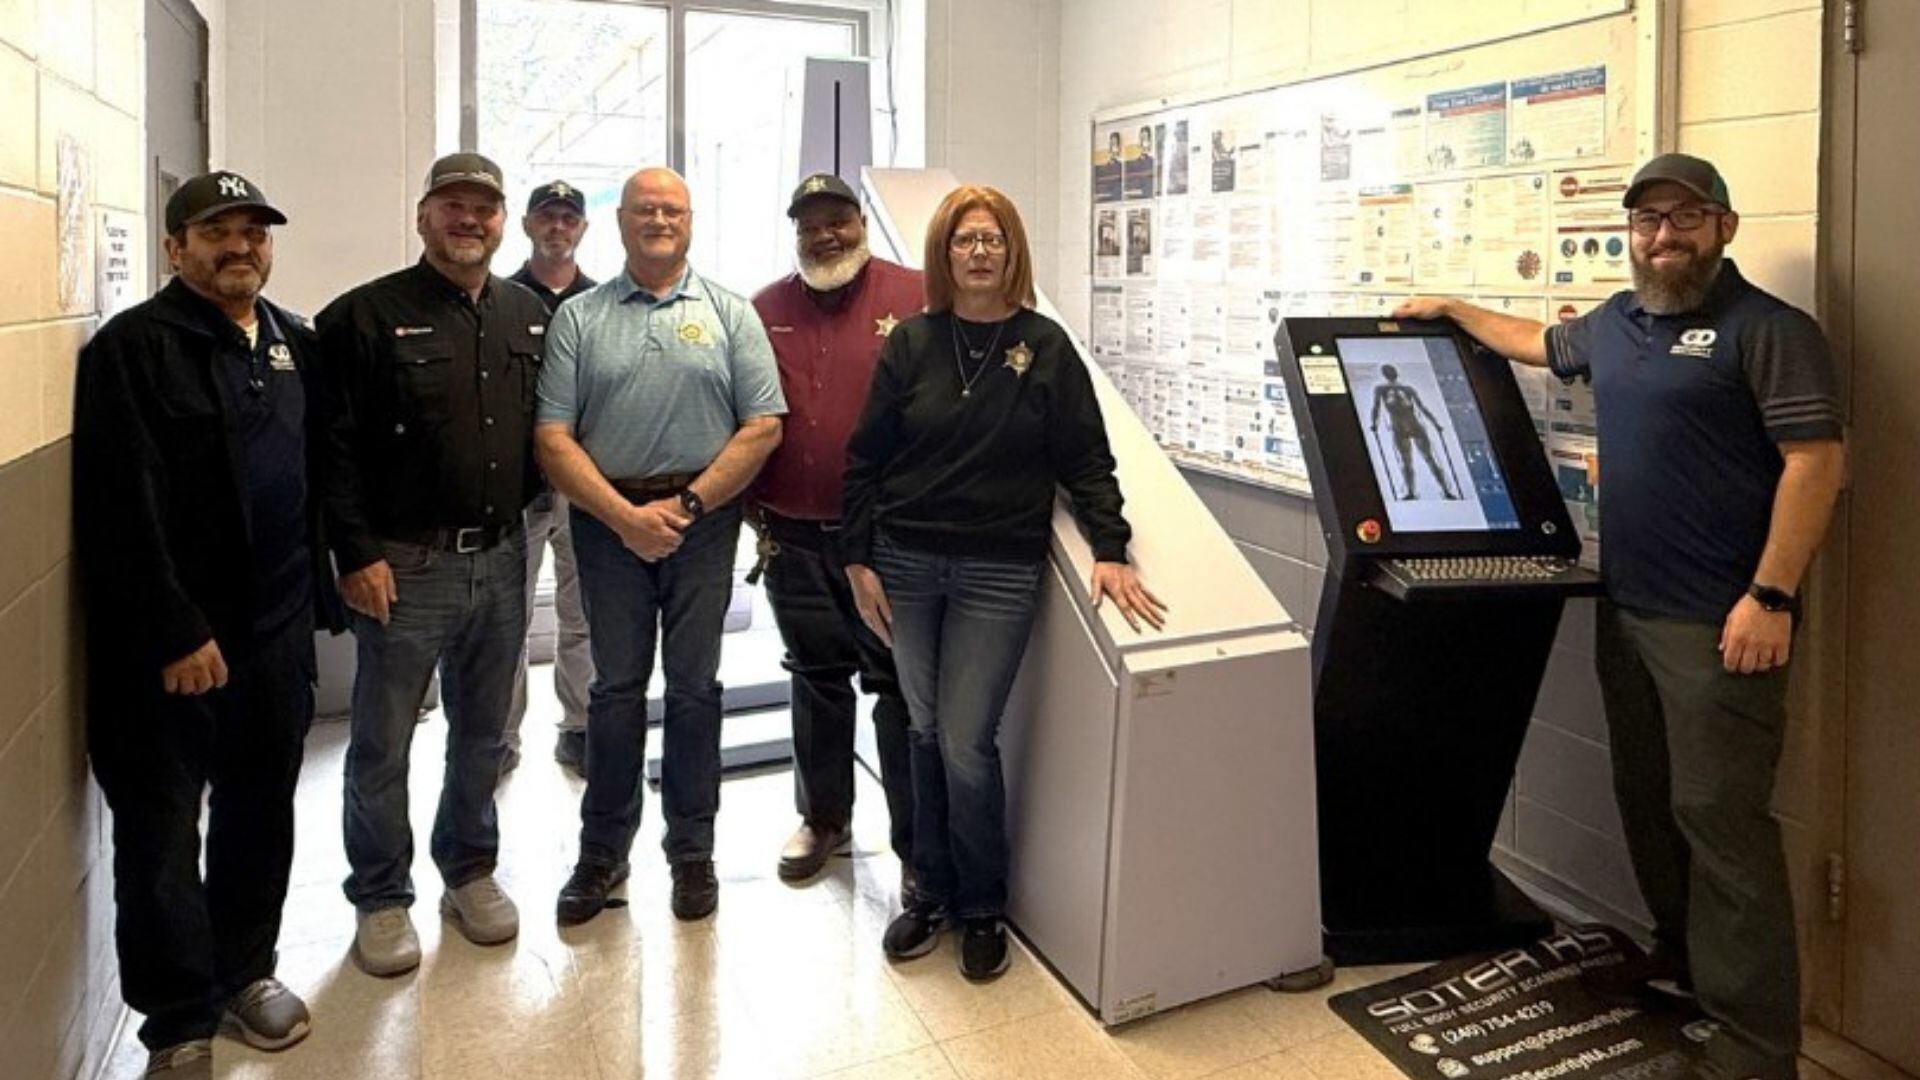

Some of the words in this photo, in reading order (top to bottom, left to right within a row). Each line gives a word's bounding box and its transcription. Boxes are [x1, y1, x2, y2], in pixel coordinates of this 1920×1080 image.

[1367, 949, 1542, 1025] SOTER
[1389, 1017, 1423, 1035] FULL
[1421, 1008, 1458, 1026] BODY
[1458, 986, 1518, 1014] SECURITY
